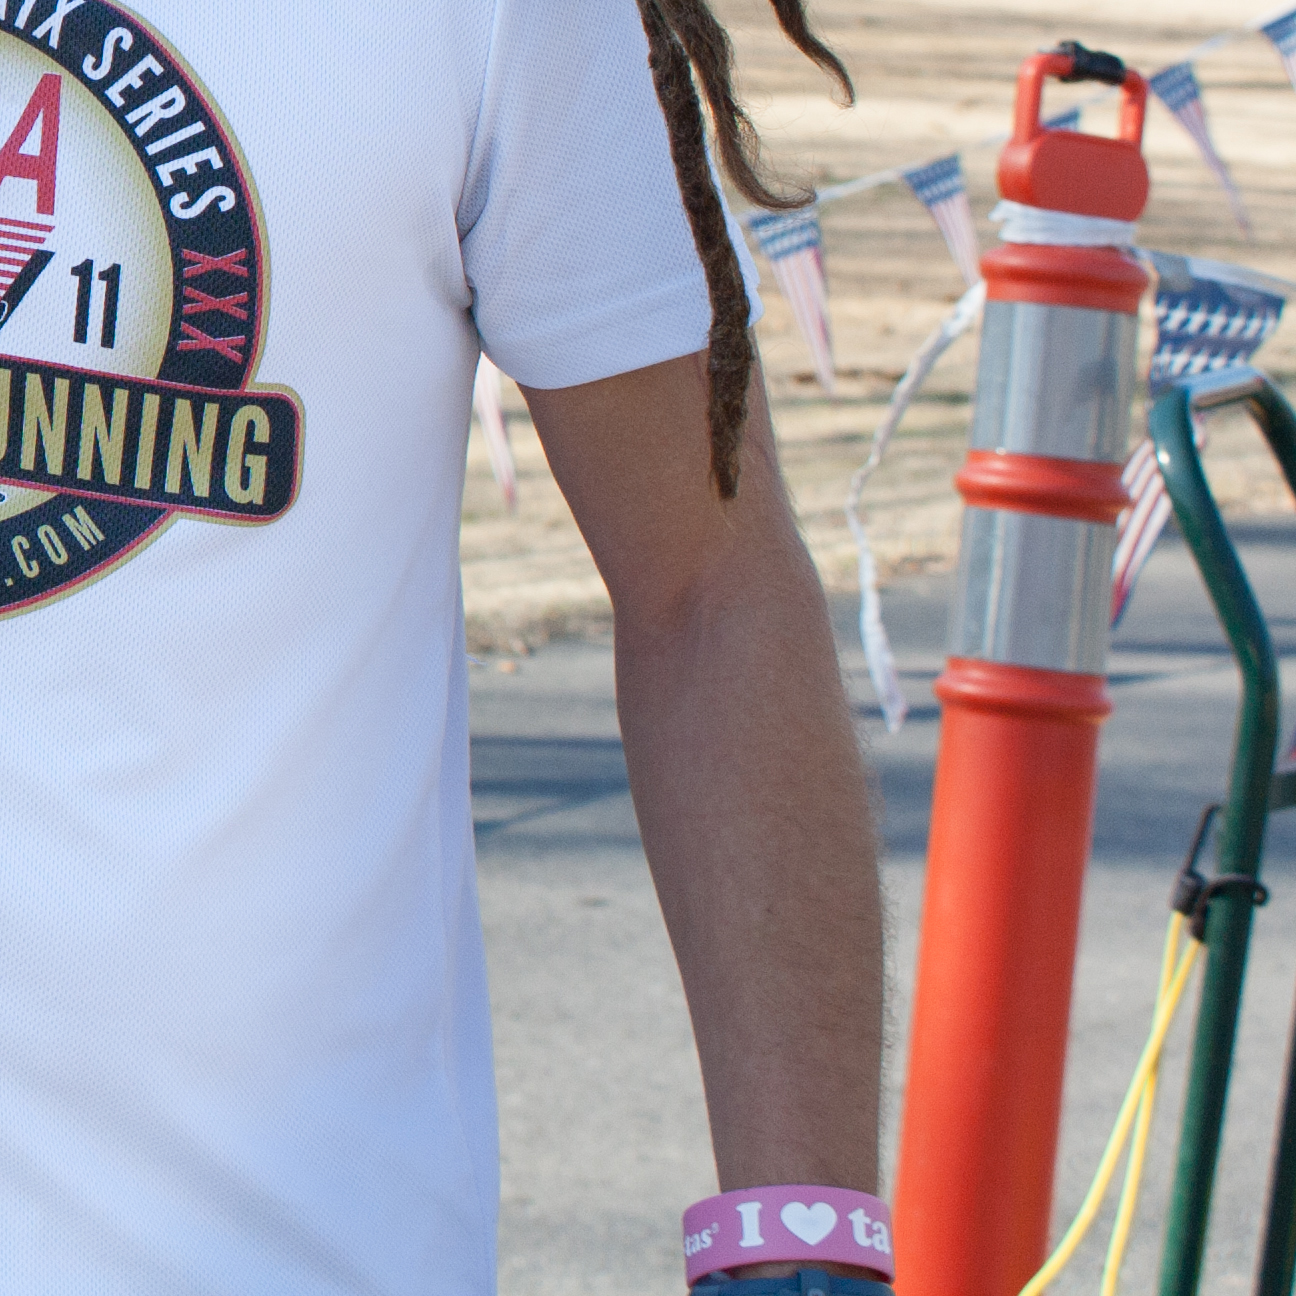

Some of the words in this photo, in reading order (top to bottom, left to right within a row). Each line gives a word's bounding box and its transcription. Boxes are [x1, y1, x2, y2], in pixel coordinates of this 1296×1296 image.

[81, 26, 236, 221] SERIES
[178, 247, 249, 365] XXX
[69, 257, 123, 350] 11
[735, 1200, 765, 1248] I
